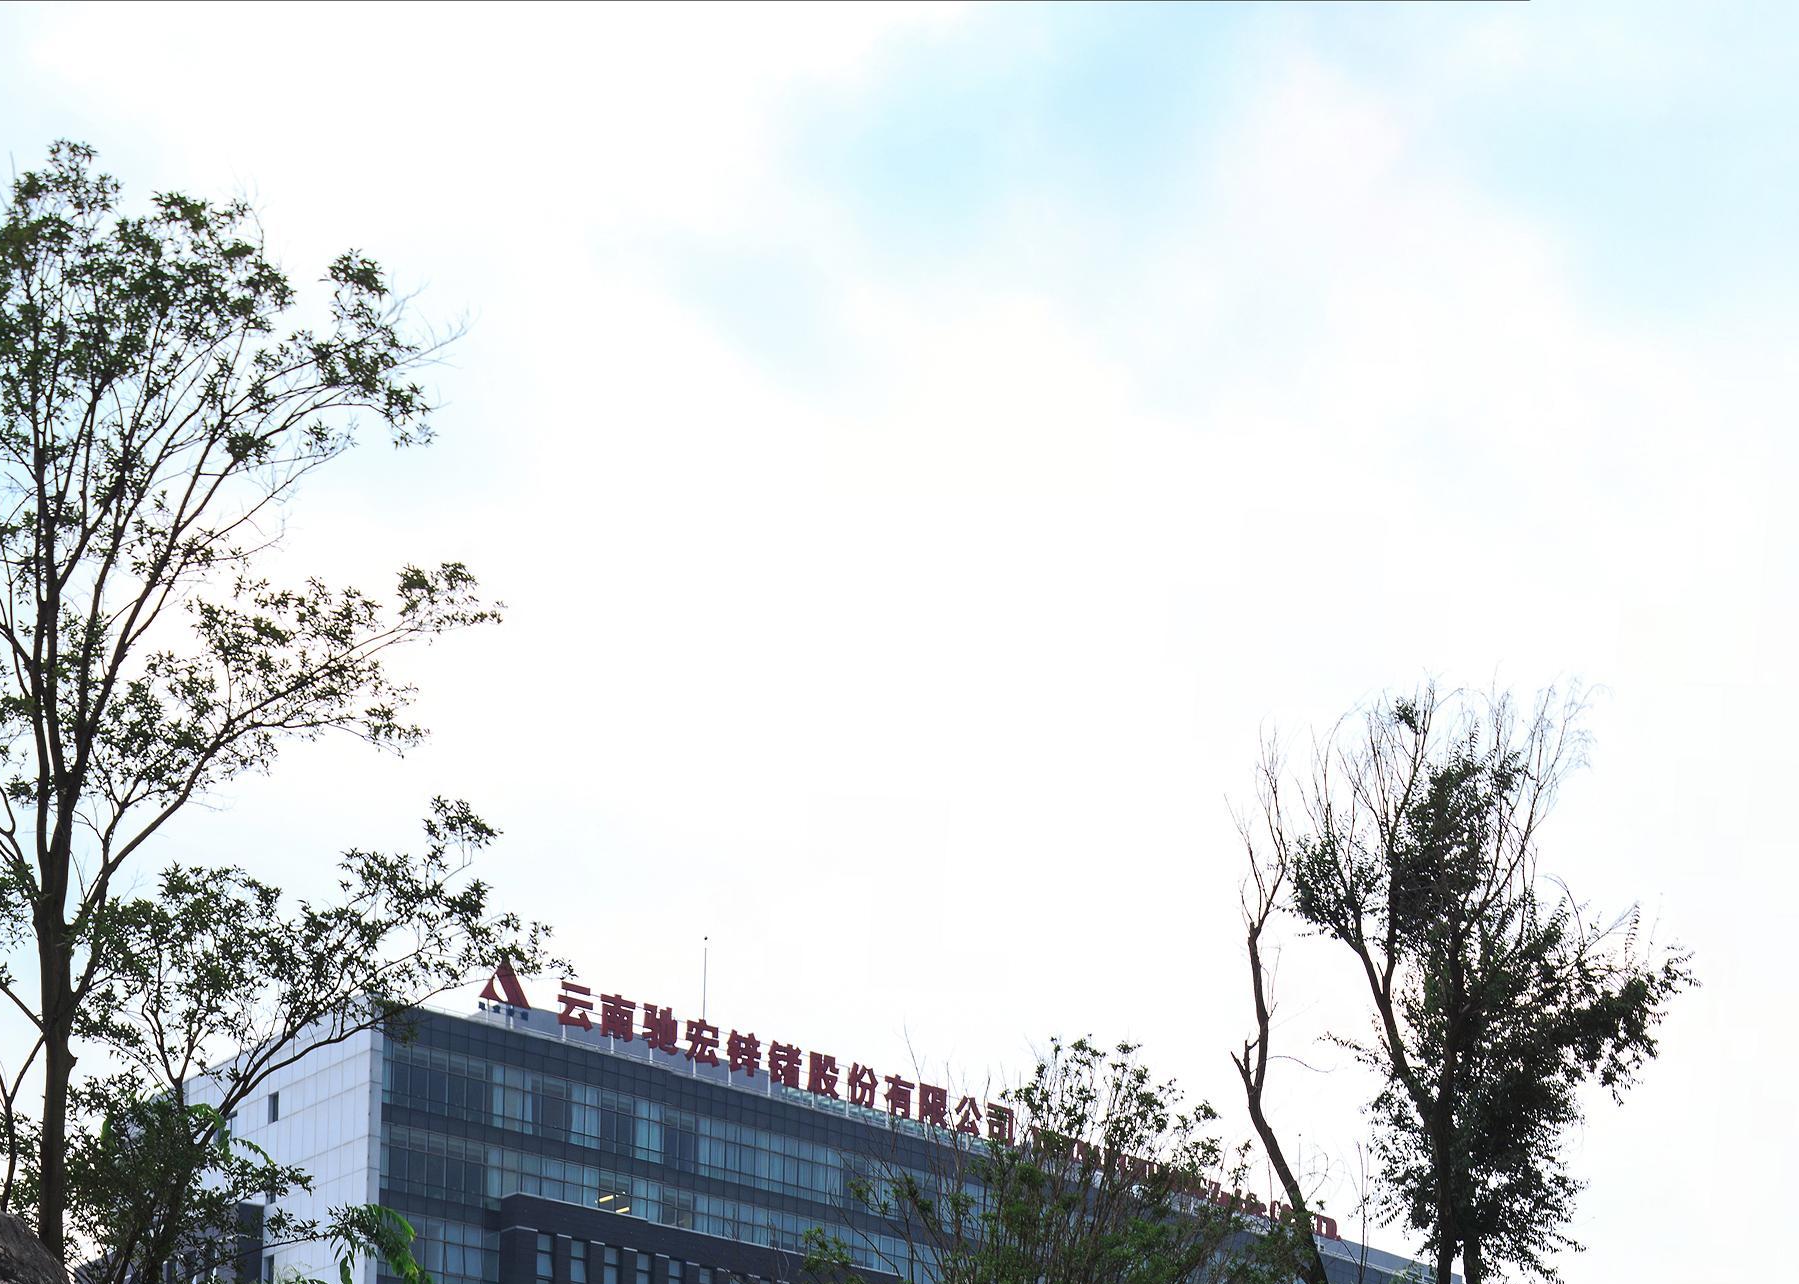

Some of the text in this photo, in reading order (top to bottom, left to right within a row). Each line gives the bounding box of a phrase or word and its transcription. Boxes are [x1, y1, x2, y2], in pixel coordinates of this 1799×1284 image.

[557, 980, 1015, 1148] 云南驰宏锌锗股份有限公司
